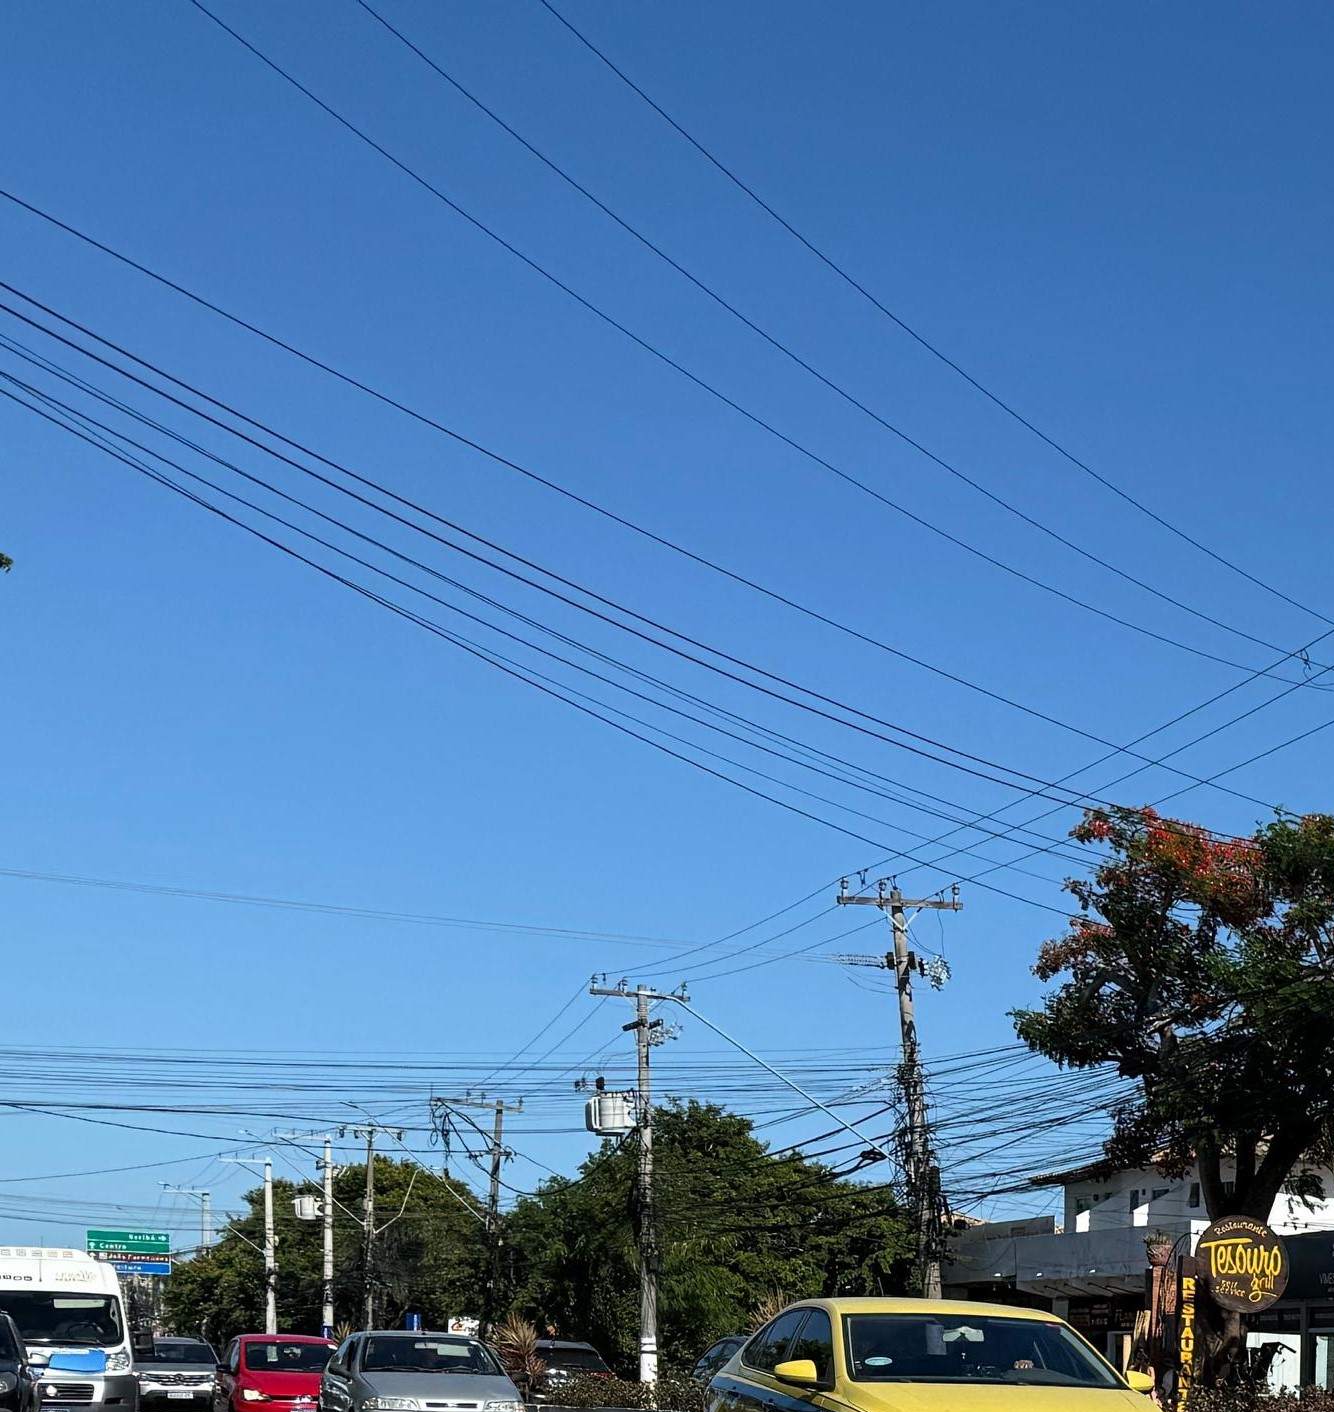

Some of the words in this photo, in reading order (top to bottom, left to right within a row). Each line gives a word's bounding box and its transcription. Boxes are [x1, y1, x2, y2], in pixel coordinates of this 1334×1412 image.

[1213, 1221, 1268, 1238] Restaurante
[99, 1242, 127, 1250] Centro
[1200, 1237, 1281, 1278] Tesouro
